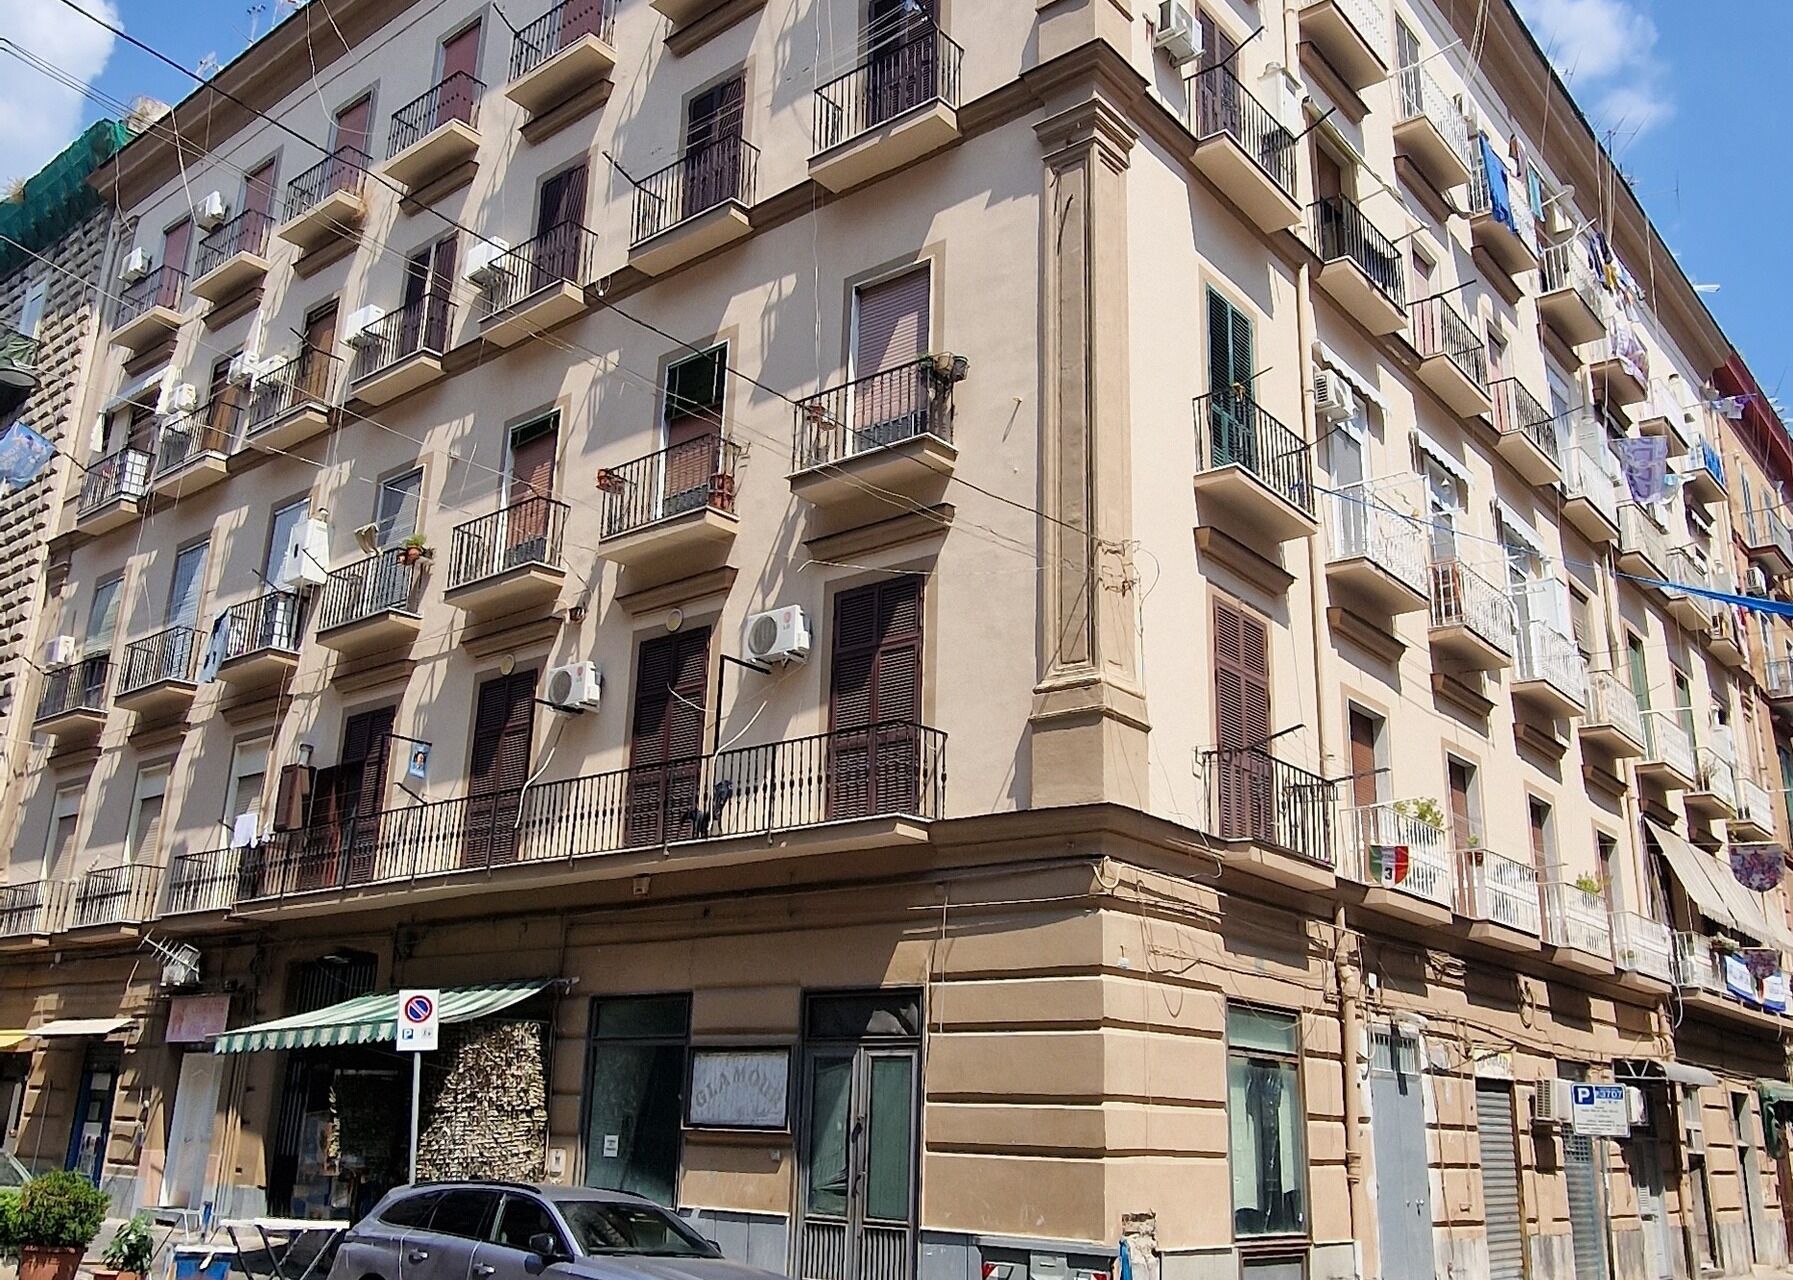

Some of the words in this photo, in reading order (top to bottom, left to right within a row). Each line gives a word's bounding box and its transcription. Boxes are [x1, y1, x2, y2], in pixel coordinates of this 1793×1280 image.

[1385, 867, 1392, 880] 3
[404, 1029, 412, 1039] P
[1577, 1087, 1590, 1103] P
